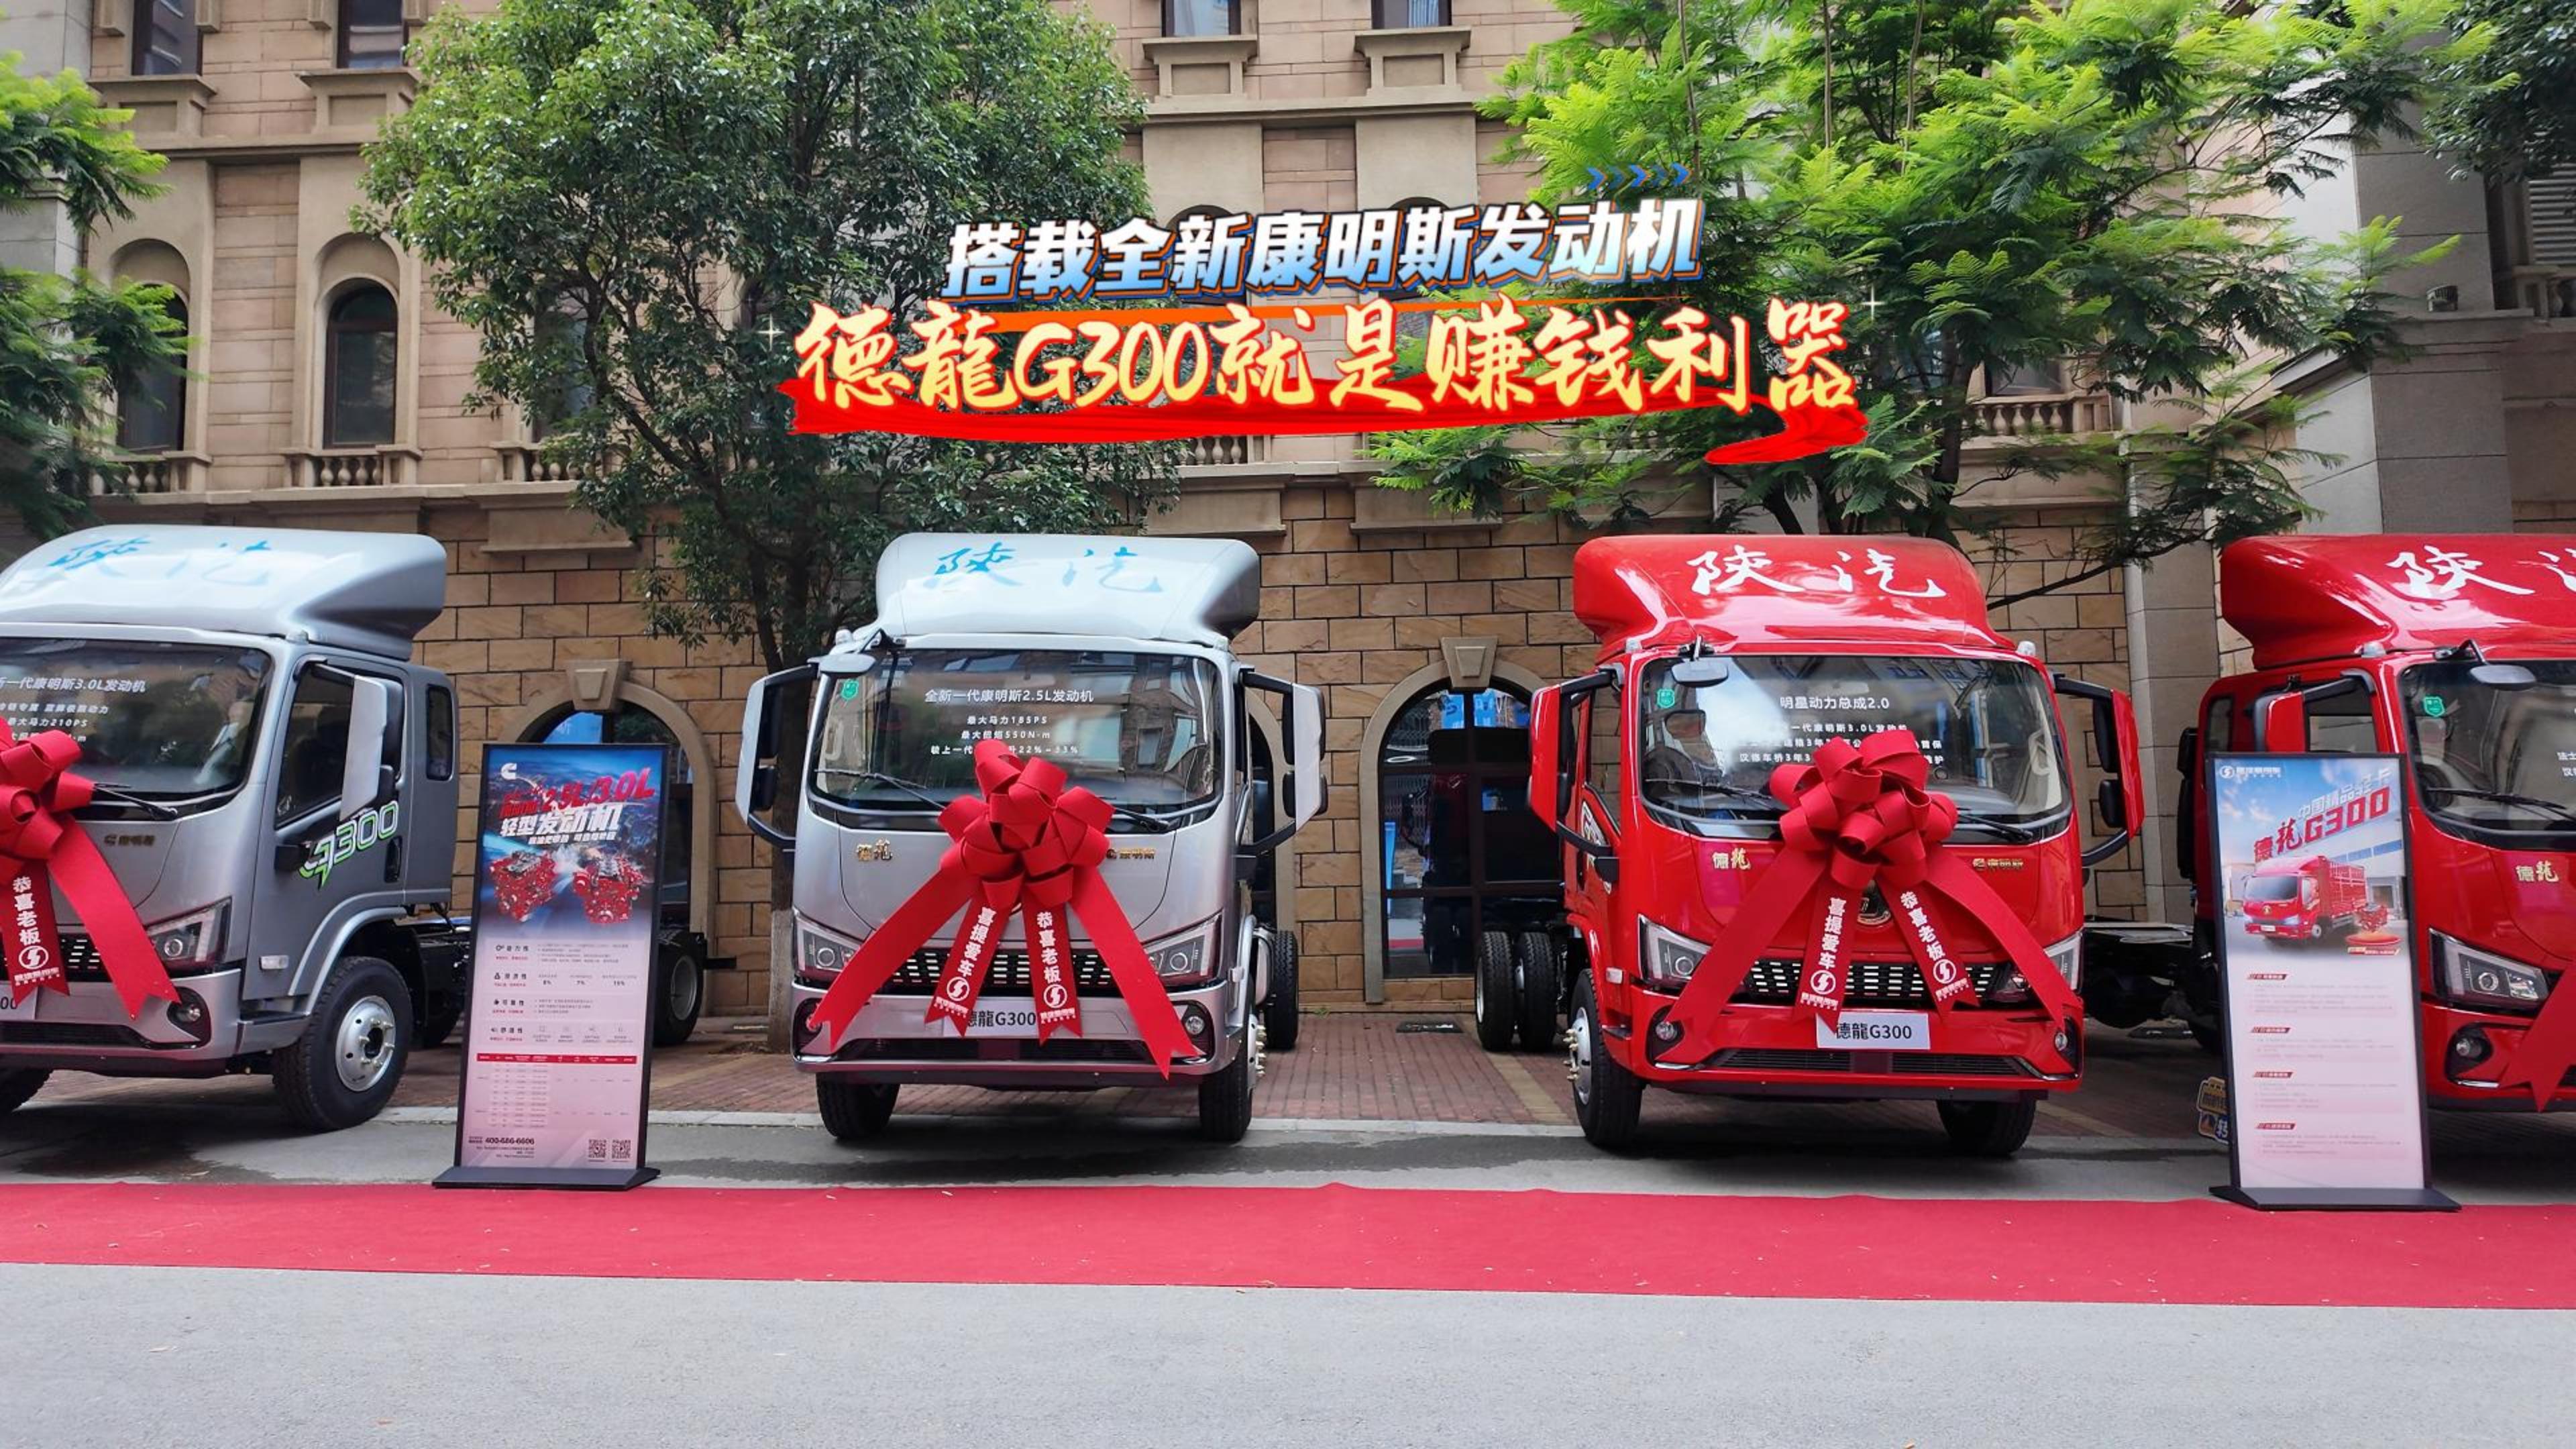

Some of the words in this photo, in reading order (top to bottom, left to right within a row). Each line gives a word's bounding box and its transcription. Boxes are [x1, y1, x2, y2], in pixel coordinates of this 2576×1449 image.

[923, 541, 1164, 593] 陕汽
[1686, 548, 1947, 598] 陕汽
[924, 689, 1094, 703] 全新一代康明斯2.5L发动机
[967, 716, 1047, 725] 最大马力185PS
[1780, 696, 1890, 709] 明星动力总成2.0
[500, 804, 623, 837] 轻型发动机
[13, 876, 41, 946] 恭喜老板
[1818, 897, 1846, 969] 喜提爱车
[1900, 891, 1945, 961] 恭喜老板
[957, 906, 997, 977] 喜提爱车
[1036, 911, 1061, 983] 恭喜老板
[1835, 1022, 1912, 1040] 德龍G300
